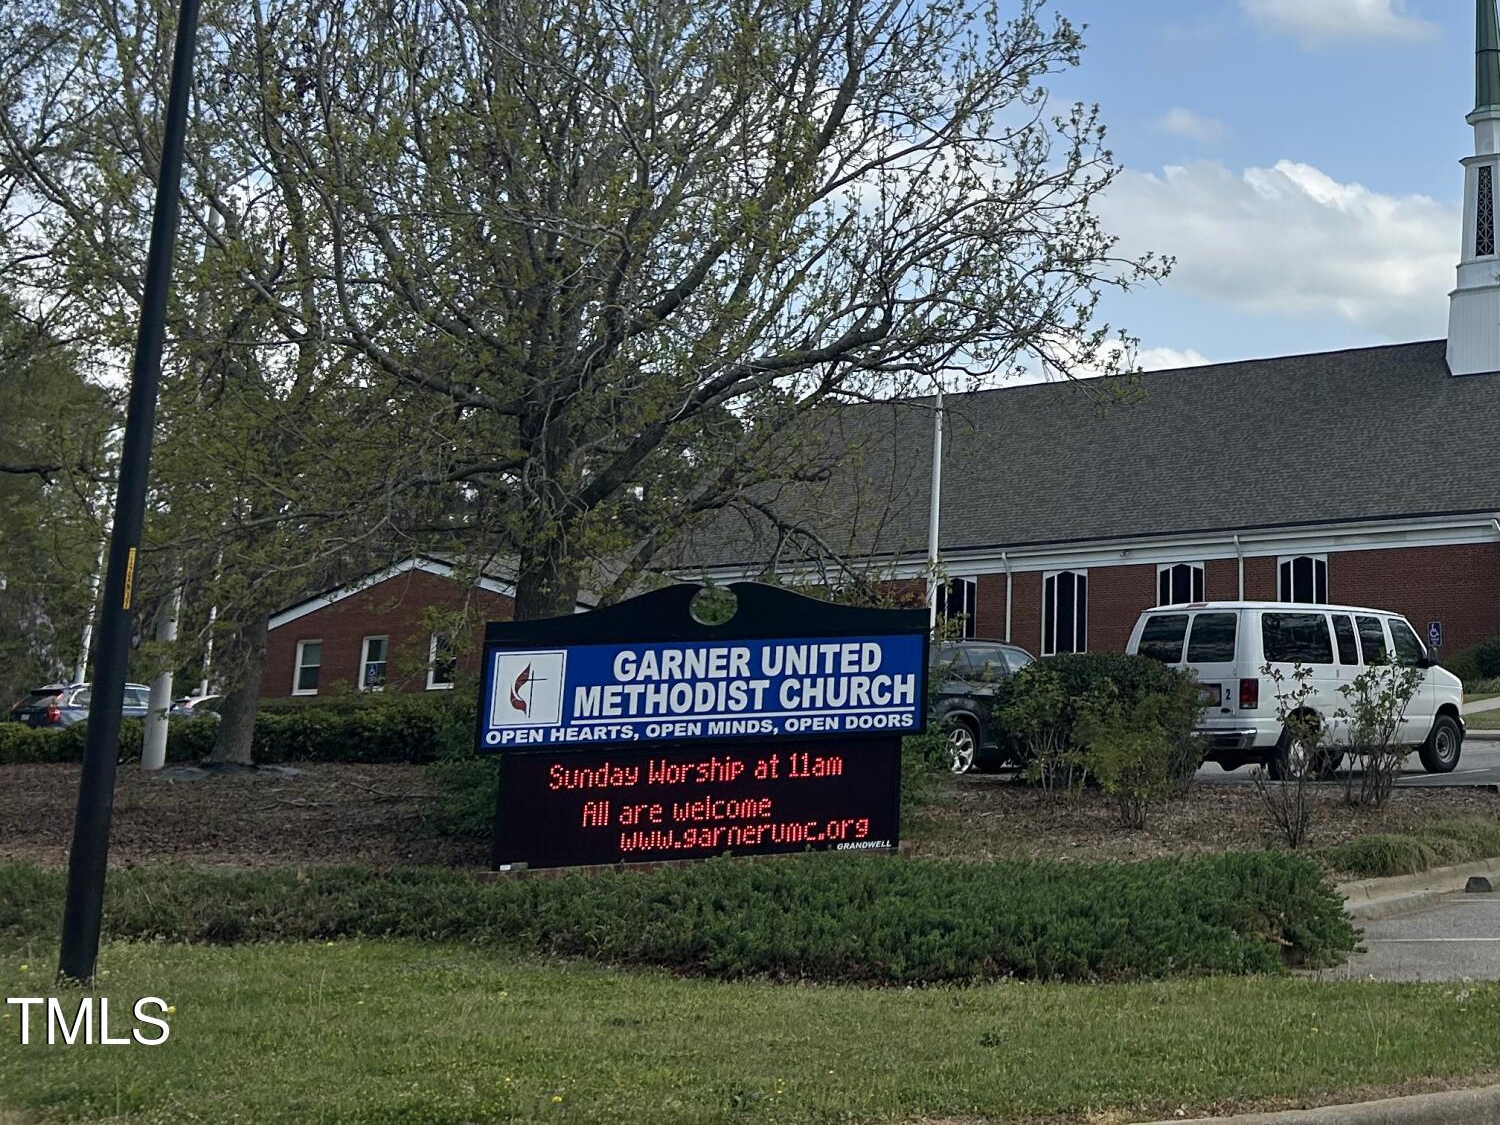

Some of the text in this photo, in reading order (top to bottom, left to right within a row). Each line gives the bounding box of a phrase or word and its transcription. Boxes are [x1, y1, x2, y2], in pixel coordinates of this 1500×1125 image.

[613, 642, 882, 682] GARNER UNITED
[573, 674, 915, 718] METHODIST CHURCH
[1225, 688, 1232, 701] 2
[485, 713, 914, 745] OPEN HEARTS, OPEN MINDS, OPEN DOORS
[549, 752, 844, 790] Sunday Worship at 11am
[583, 795, 772, 827] All are welcome
[619, 818, 870, 852] www.garnerumc.org
[836, 840, 892, 851] GRANDWELL
